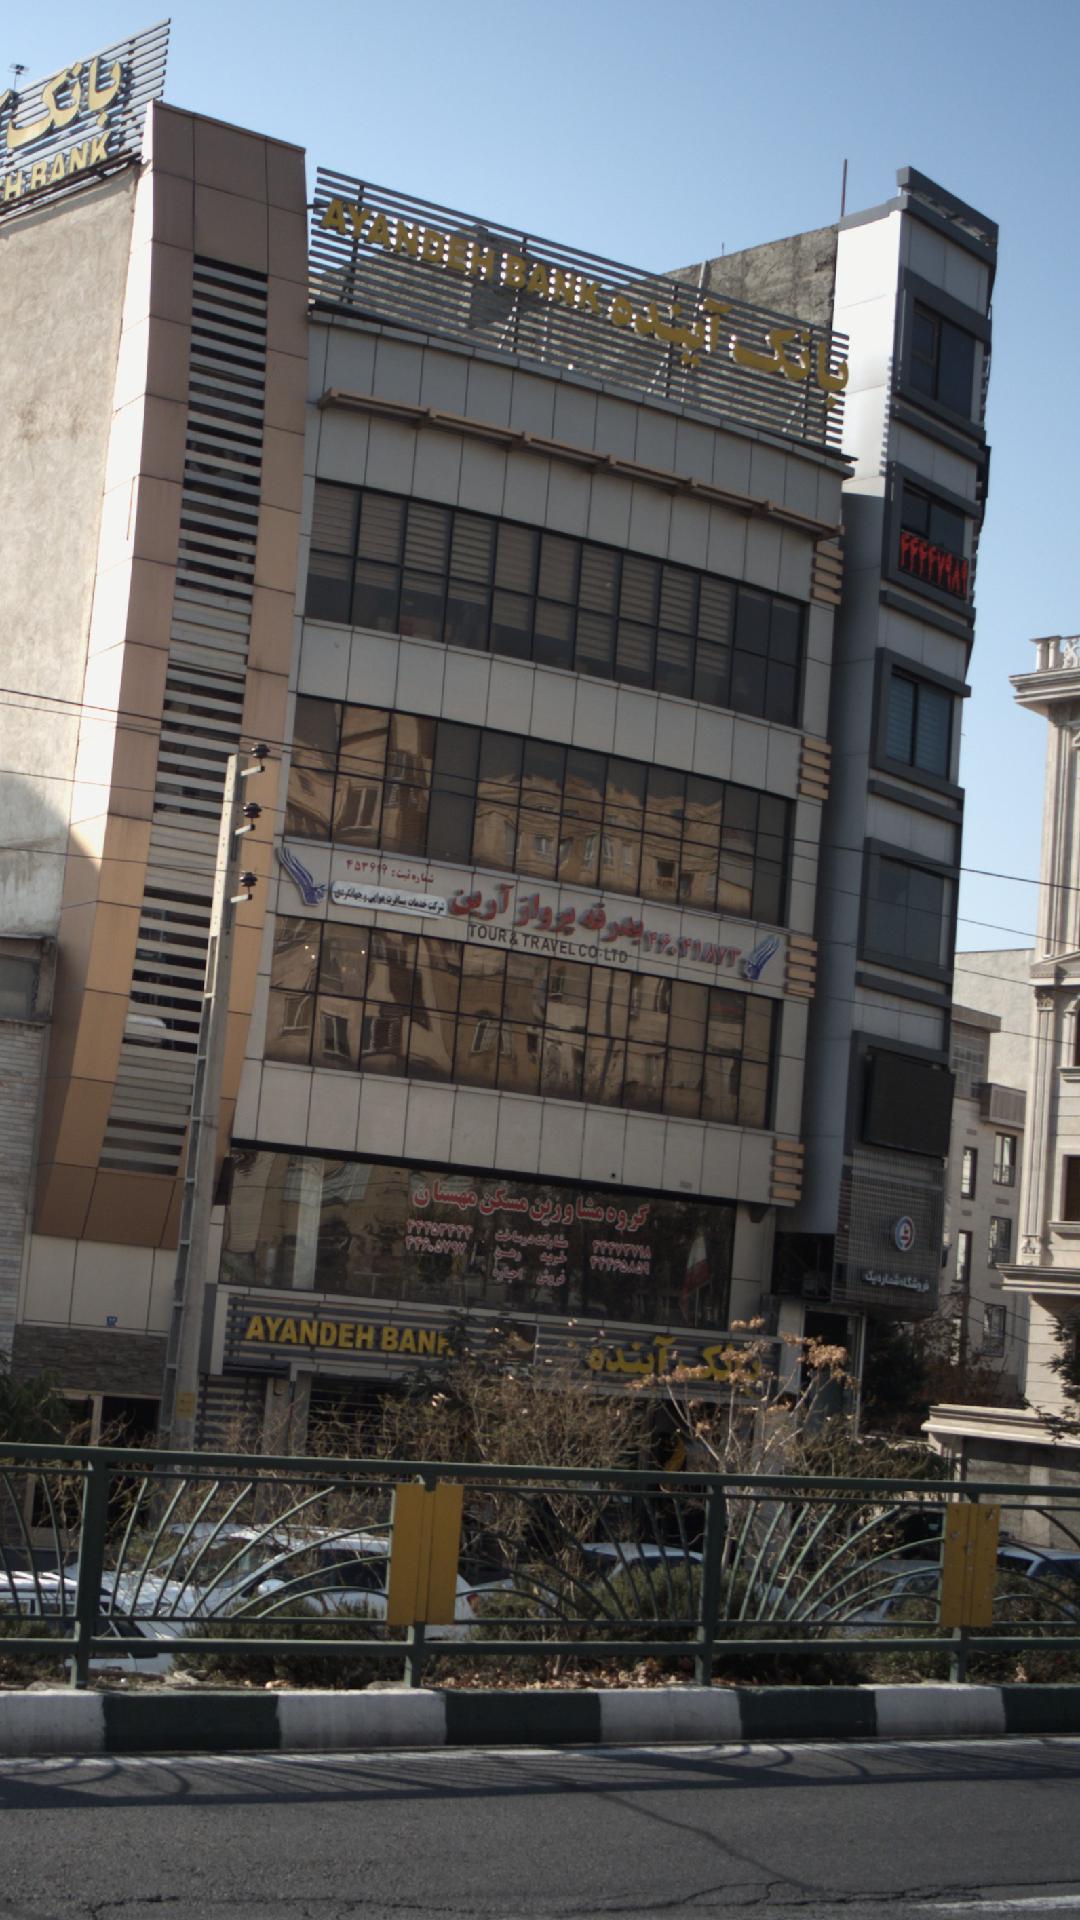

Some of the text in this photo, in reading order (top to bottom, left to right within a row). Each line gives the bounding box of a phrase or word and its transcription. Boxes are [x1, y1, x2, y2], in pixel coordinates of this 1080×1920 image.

[7, 56, 122, 149] بانک
[30, 131, 110, 192] BANK
[320, 198, 604, 315] AYANDEH BANK
[610, 297, 849, 409] بانک آینده
[411, 871, 434, 884] شماره
[448, 883, 514, 921] آرین
[513, 892, 576, 936] پرواز
[468, 924, 507, 943] TOUR
[509, 932, 518, 946] &
[522, 934, 575, 956] TRAVEL
[479, 1184, 529, 1215] مسکن
[529, 1195, 605, 1226] مشاورین
[605, 1203, 651, 1232] گروه
[539, 1250, 568, 1266] خرید
[492, 1265, 566, 1287] فروش اجاره
[245, 1314, 375, 1350] AYANDEH
